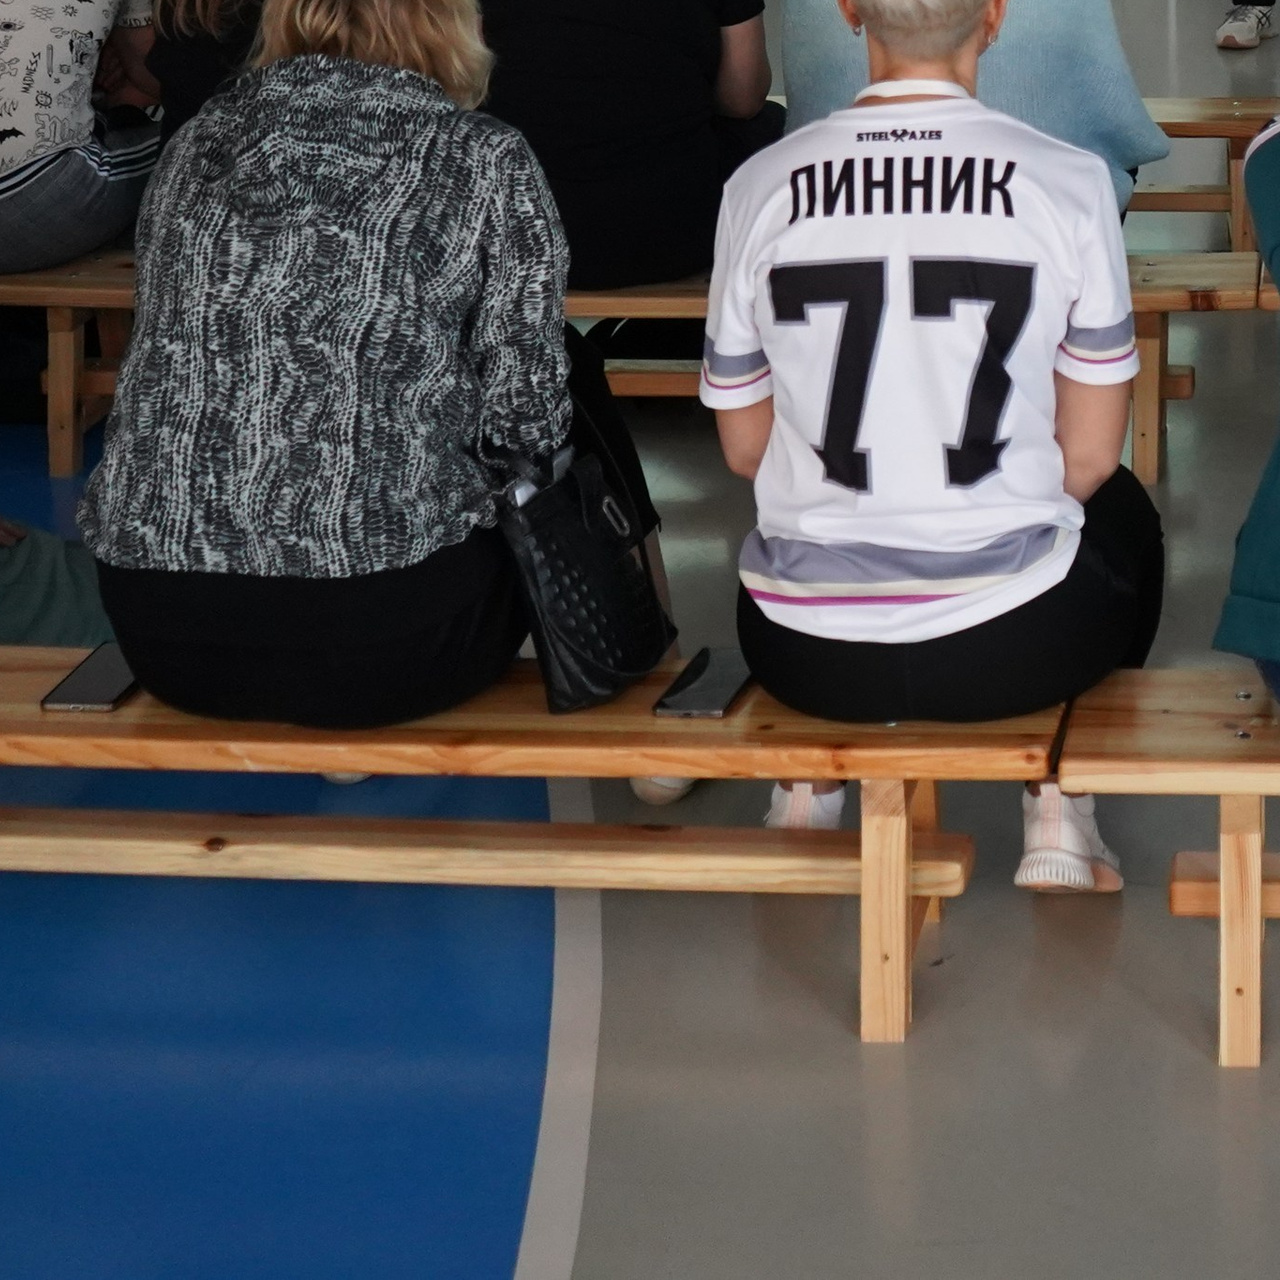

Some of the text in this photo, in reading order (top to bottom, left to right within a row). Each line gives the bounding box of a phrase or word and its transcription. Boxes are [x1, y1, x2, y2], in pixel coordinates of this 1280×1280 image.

[21, 51, 41, 94] MADNESS
[856, 130, 943, 142] STEEL AXES
[788, 156, 1018, 225] ЛИННИК
[768, 255, 1039, 495] 77
